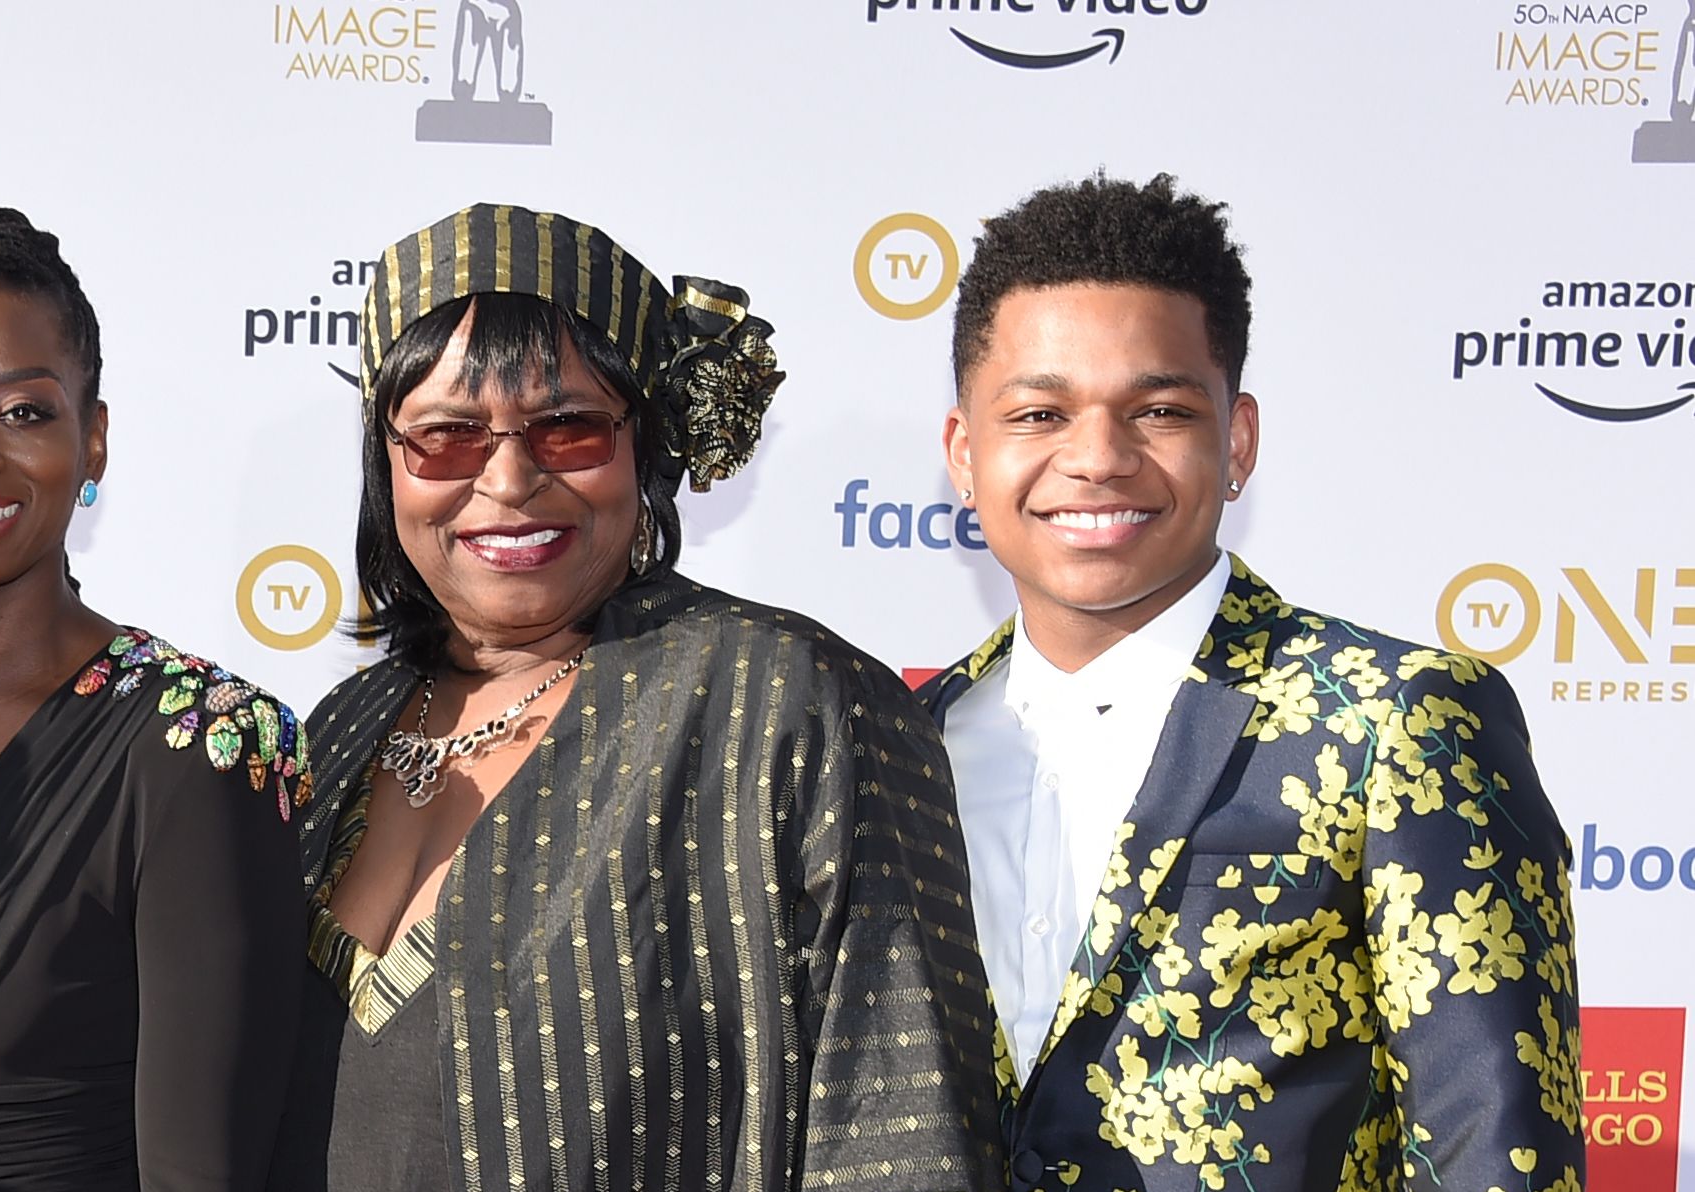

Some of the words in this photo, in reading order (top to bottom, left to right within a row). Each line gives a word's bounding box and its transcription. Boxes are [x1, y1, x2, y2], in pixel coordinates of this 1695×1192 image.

[274, 4, 437, 49] IMAGE
[1562, 4, 1648, 25] NAACP
[1495, 31, 1660, 72] IMAGE
[884, 253, 929, 281] TV
[1453, 317, 1622, 380] prime
[1637, 317, 1695, 367] vi
[834, 479, 989, 551] face
[267, 585, 312, 612] TV
[1467, 602, 1510, 629] TV
